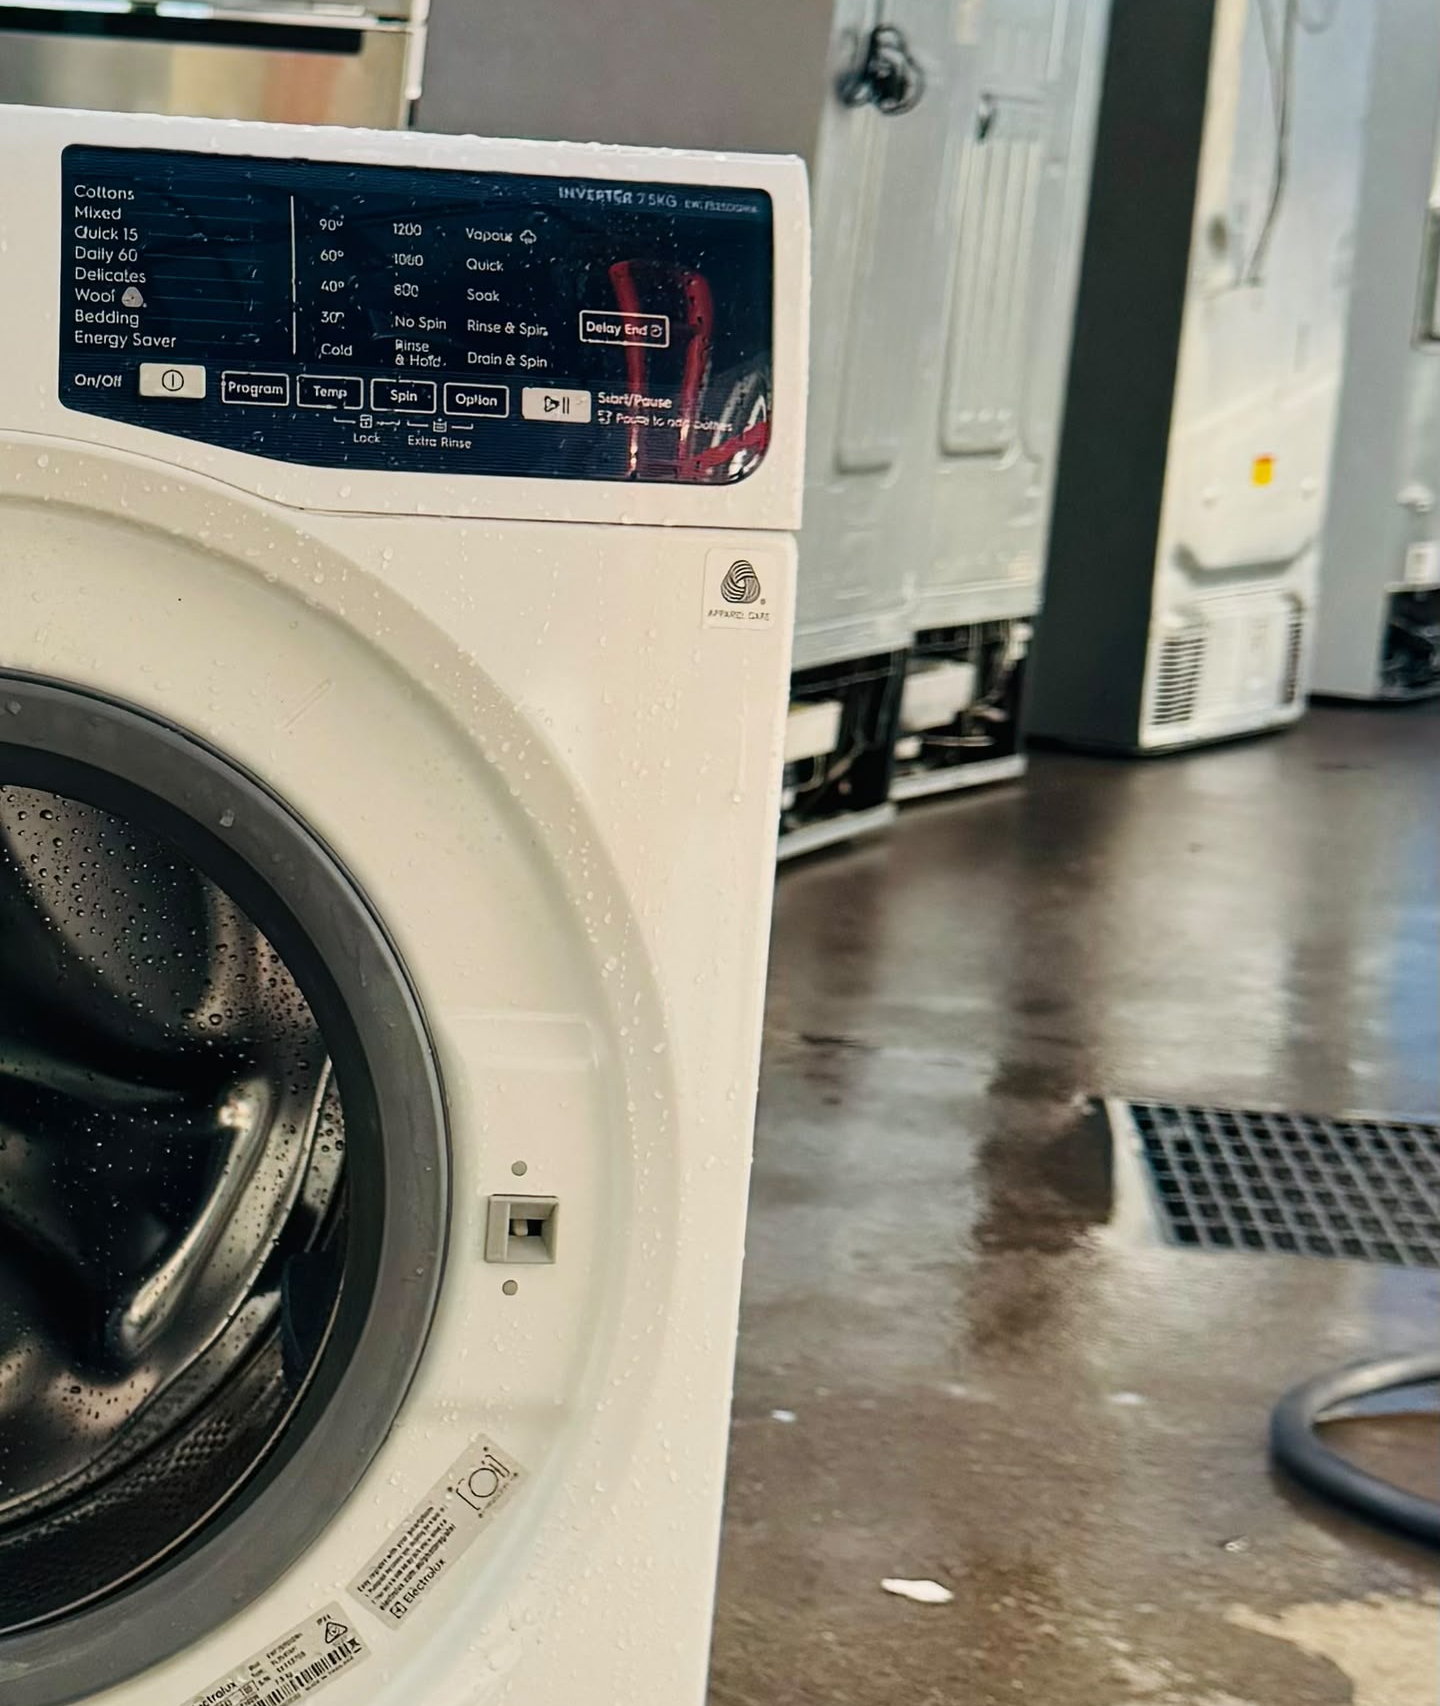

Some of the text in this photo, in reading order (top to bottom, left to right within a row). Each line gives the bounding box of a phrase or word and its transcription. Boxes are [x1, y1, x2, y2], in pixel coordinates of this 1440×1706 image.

[74, 184, 135, 201] Cottons
[559, 186, 633, 205] INVERTER
[74, 206, 121, 221] Mixed
[74, 227, 138, 241] Quick 15
[393, 223, 422, 236] 1200
[465, 228, 513, 243] Vapour
[75, 247, 138, 264] Daily 60
[320, 249, 344, 261] 60°
[393, 253, 424, 266] 1000
[466, 258, 504, 272] Quick
[75, 267, 146, 284] Delicates
[320, 280, 345, 292] 40°
[394, 284, 419, 297] 800
[75, 287, 115, 304] Wool
[467, 288, 500, 302] Soak
[75, 309, 139, 328] Bedding
[395, 315, 447, 331] No Spin
[467, 319, 547, 337] Rinse & Spin
[586, 320, 648, 337] Delay End
[75, 331, 176, 349] Energy Saver
[395, 340, 430, 353] Rinse
[320, 343, 353, 356] Cold
[395, 354, 442, 367] & Hold
[467, 351, 548, 369] Drain & Spin
[74, 374, 122, 388] On/Off
[228, 380, 284, 397] Program
[313, 385, 347, 399] Temp
[390, 389, 417, 402] Spin
[455, 393, 497, 407] Option
[598, 391, 673, 409] Start/Pause
[353, 432, 380, 443] Lock
[408, 435, 472, 449] Extra Rinse
[403, 1557, 447, 1605] Electrolux
